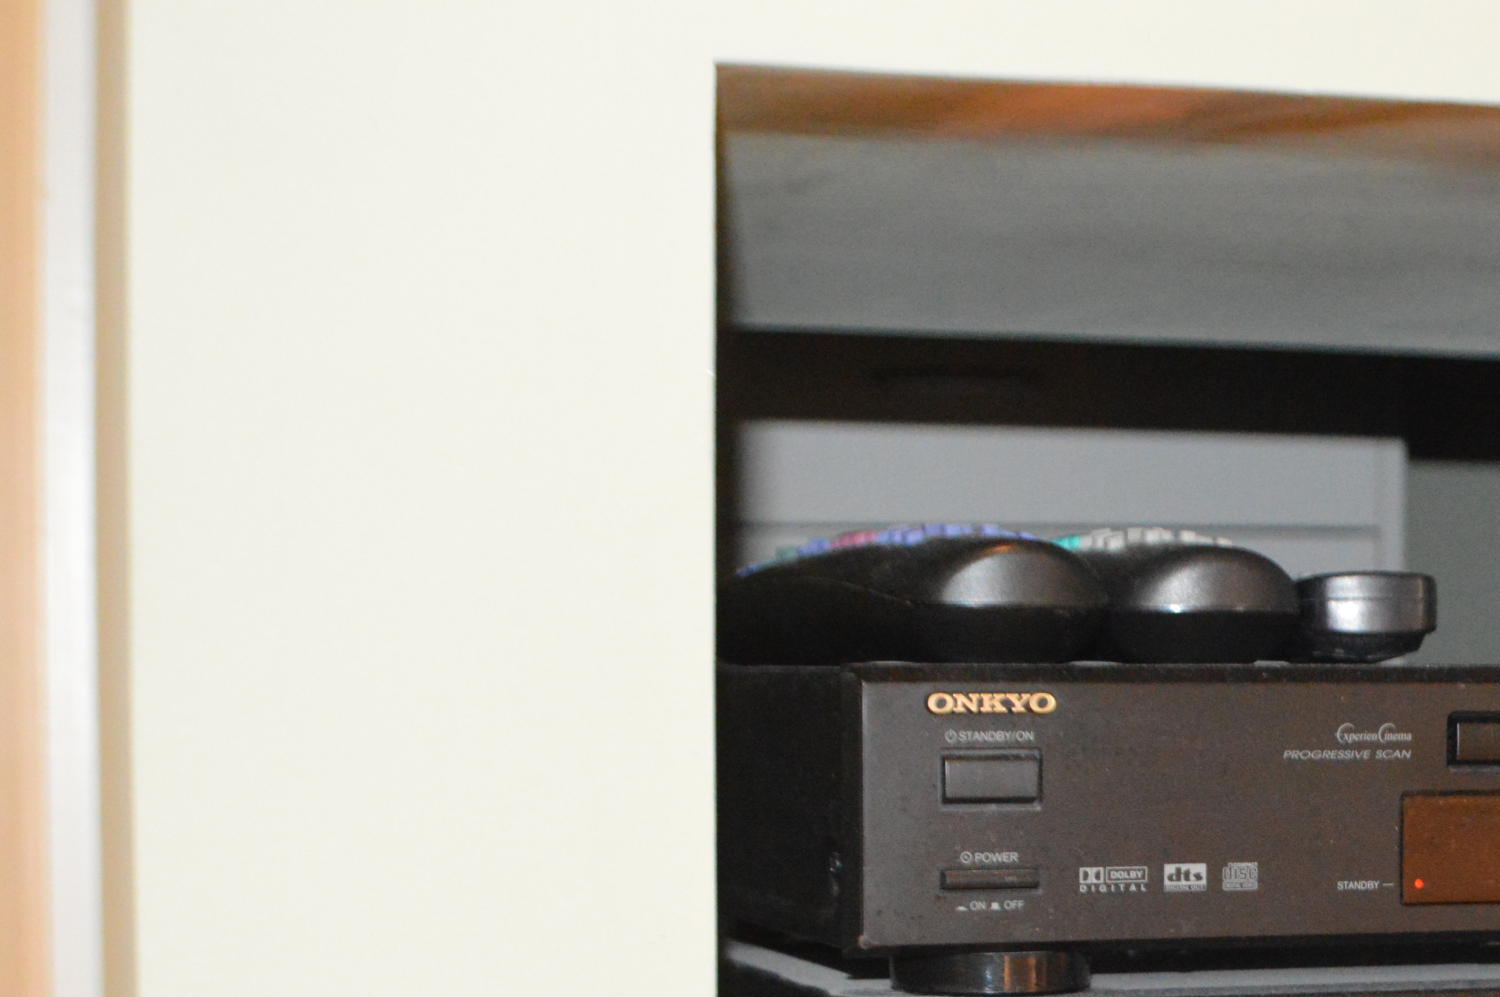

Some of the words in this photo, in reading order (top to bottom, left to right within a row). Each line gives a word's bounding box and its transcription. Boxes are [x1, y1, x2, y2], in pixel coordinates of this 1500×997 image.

[926, 692, 1057, 715] ONKYO
[957, 730, 1035, 742] STANDBY/ON
[1283, 750, 1371, 760] PROGRESSIVE
[1375, 749, 1412, 759] SCAN
[973, 852, 1019, 864] POWER
[1109, 870, 1144, 880] DOLBY
[1166, 866, 1204, 882] dts
[1079, 883, 1148, 893] DIGITAL
[1336, 880, 1380, 890] STANDBY
[969, 900, 987, 911] ON
[1003, 899, 1025, 911] OFF
